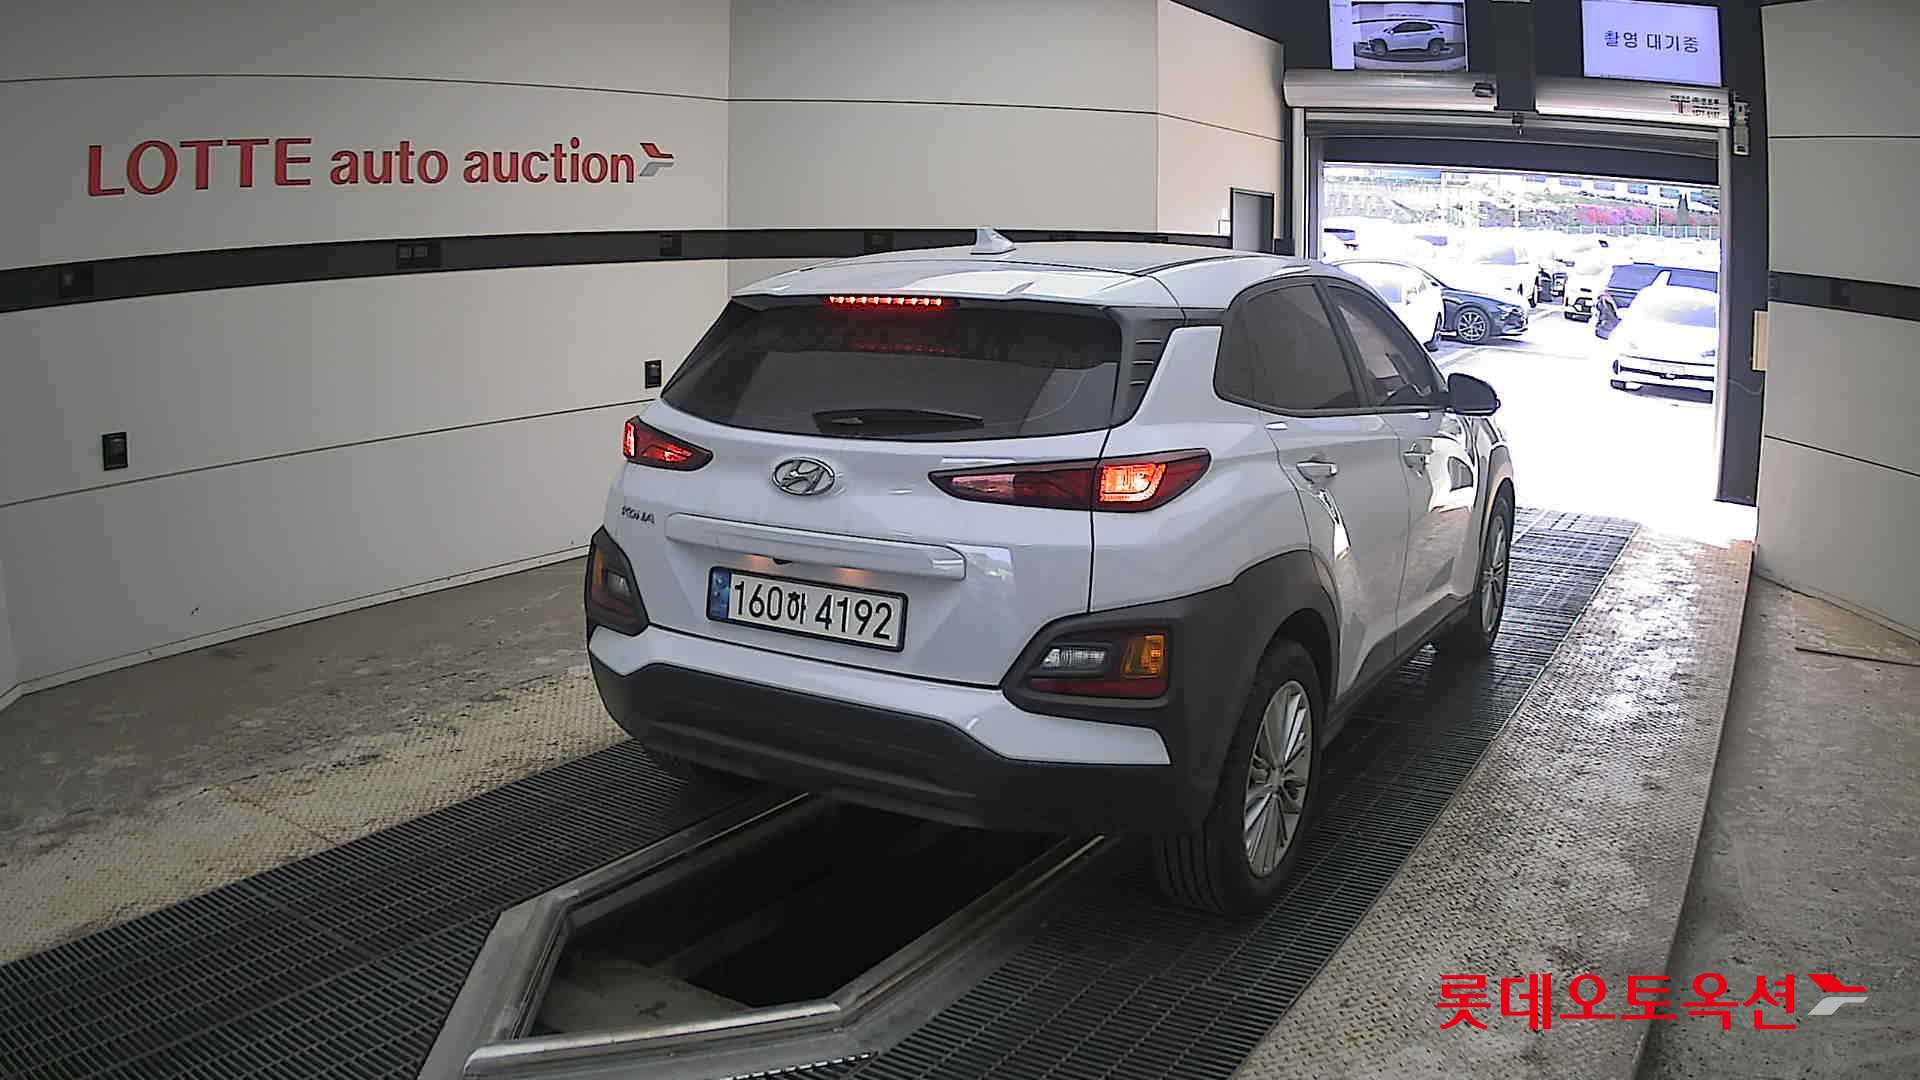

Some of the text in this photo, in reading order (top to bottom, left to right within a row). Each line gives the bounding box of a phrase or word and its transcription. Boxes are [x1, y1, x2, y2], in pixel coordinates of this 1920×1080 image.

[1646, 32, 1700, 53] 대기중
[87, 138, 635, 196] LOTTE auto auction
[734, 581, 807, 625] 160하
[815, 594, 893, 640] 4192
